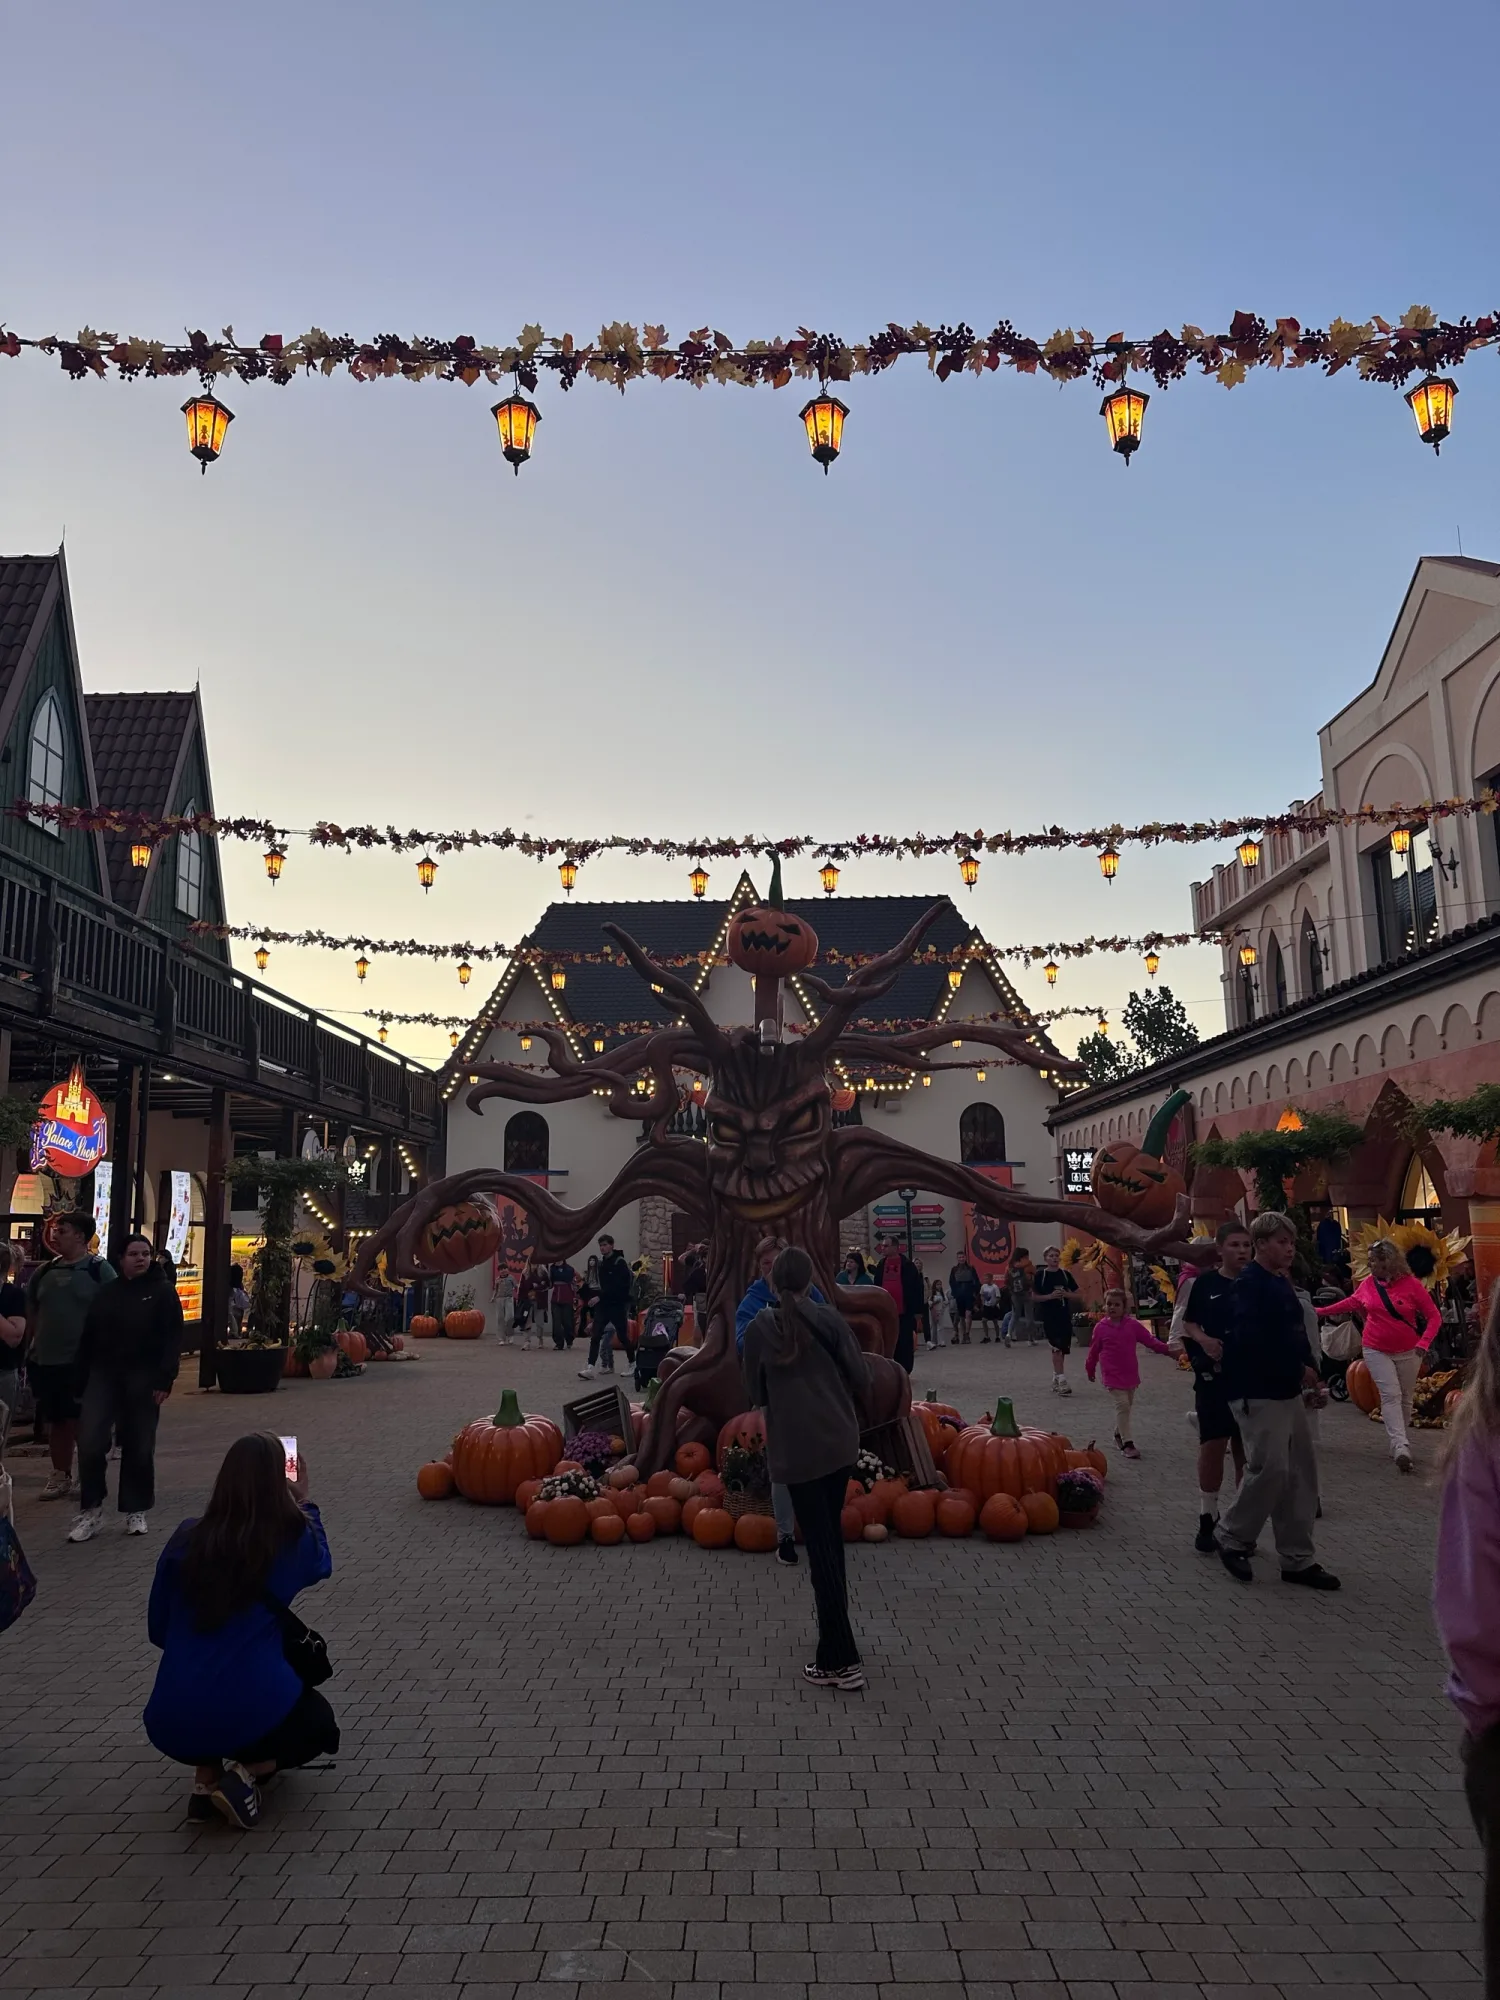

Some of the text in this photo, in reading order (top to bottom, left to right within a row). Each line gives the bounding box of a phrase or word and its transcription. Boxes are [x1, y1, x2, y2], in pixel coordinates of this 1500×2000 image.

[41, 1121, 96, 1166] Palace Shop
[1067, 1184, 1083, 1192] WC
